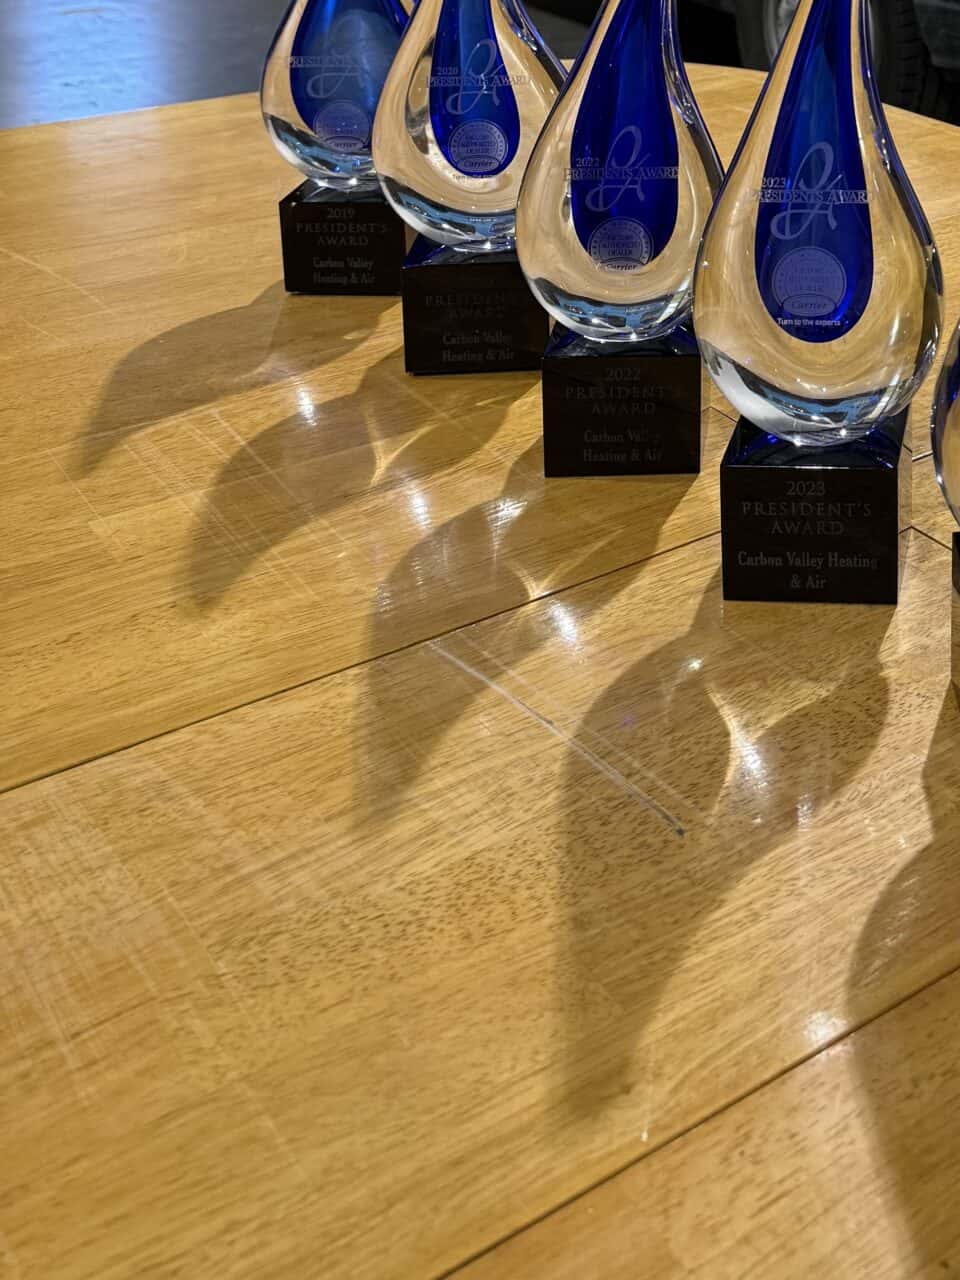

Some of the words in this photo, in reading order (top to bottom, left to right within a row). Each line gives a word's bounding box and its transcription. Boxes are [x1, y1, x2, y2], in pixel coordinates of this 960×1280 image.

[762, 176, 786, 187] 2023
[786, 480, 826, 496] 2023
[741, 501, 872, 517] PRESIDENT'S
[770, 520, 845, 535] AWARD
[786, 551, 825, 569] Valley
[828, 552, 879, 571] Heating
[791, 574, 800, 588] &
[806, 574, 827, 589] Air
